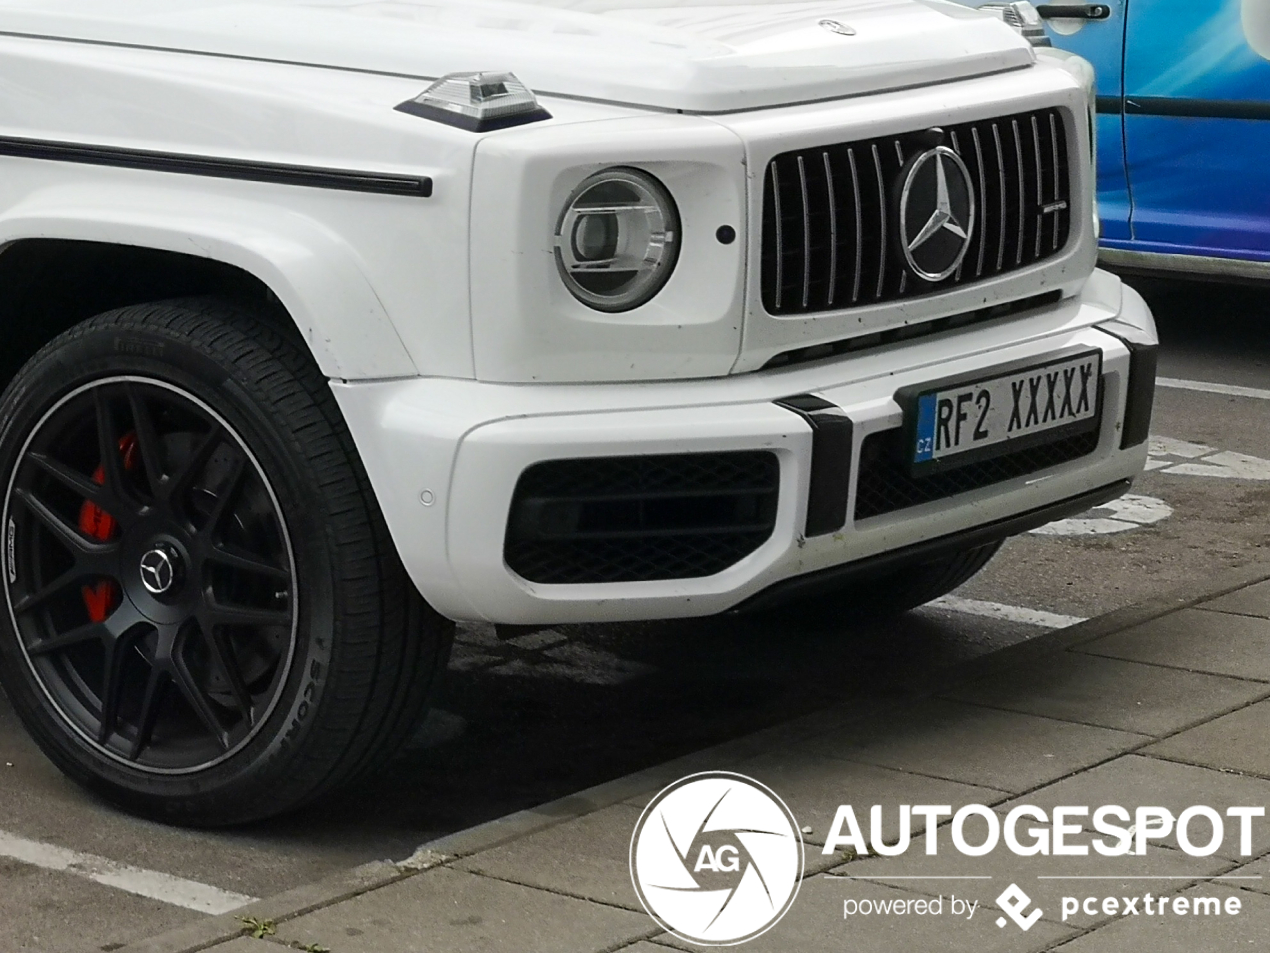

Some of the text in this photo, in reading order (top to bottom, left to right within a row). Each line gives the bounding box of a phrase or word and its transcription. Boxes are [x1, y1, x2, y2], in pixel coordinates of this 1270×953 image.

[935, 363, 1092, 450] RF2 XXXXX
[917, 437, 932, 454] CZ
